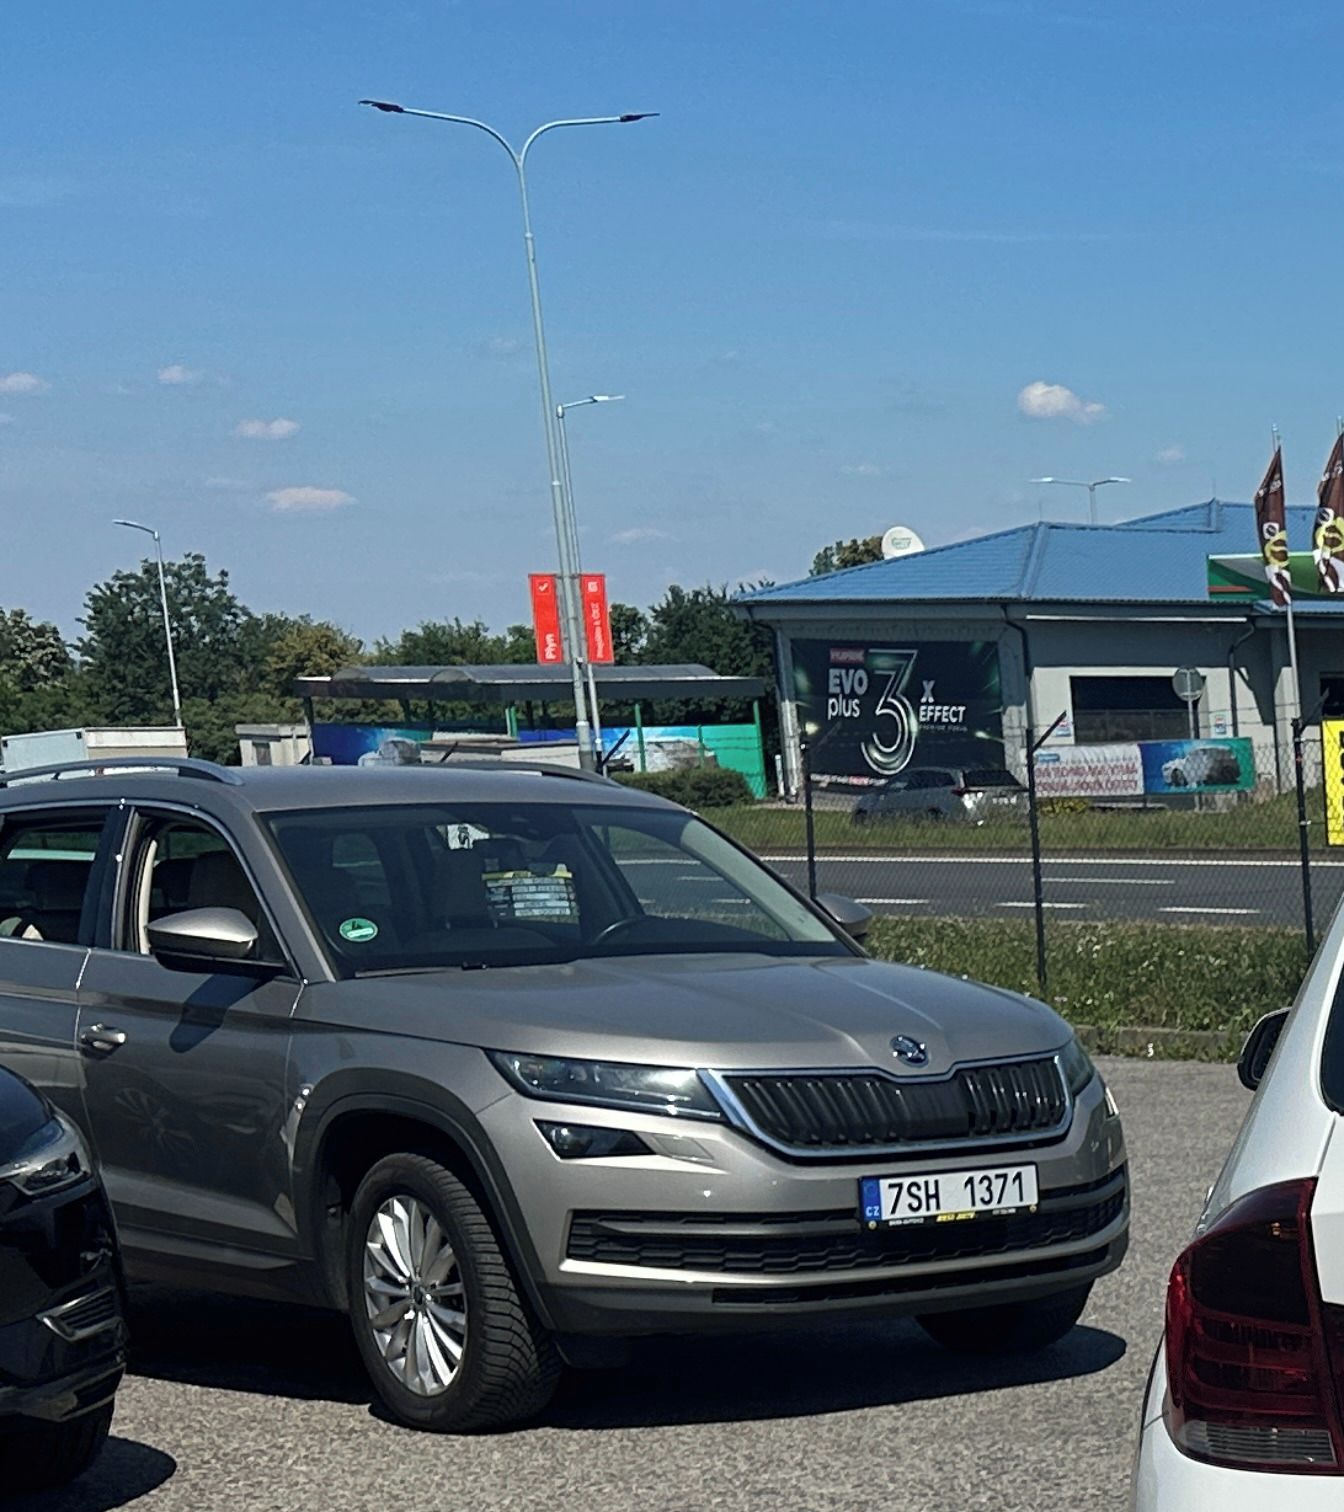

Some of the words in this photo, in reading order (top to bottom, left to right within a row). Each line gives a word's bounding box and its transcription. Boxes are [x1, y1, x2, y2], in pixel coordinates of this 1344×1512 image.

[828, 668, 868, 695] EVO
[920, 680, 935, 703] X
[827, 693, 860, 720] plus
[919, 705, 966, 723] EFFECT
[888, 1178, 941, 1215] 7SH
[964, 1170, 1025, 1208] 1371
[865, 1204, 880, 1217] CZ
